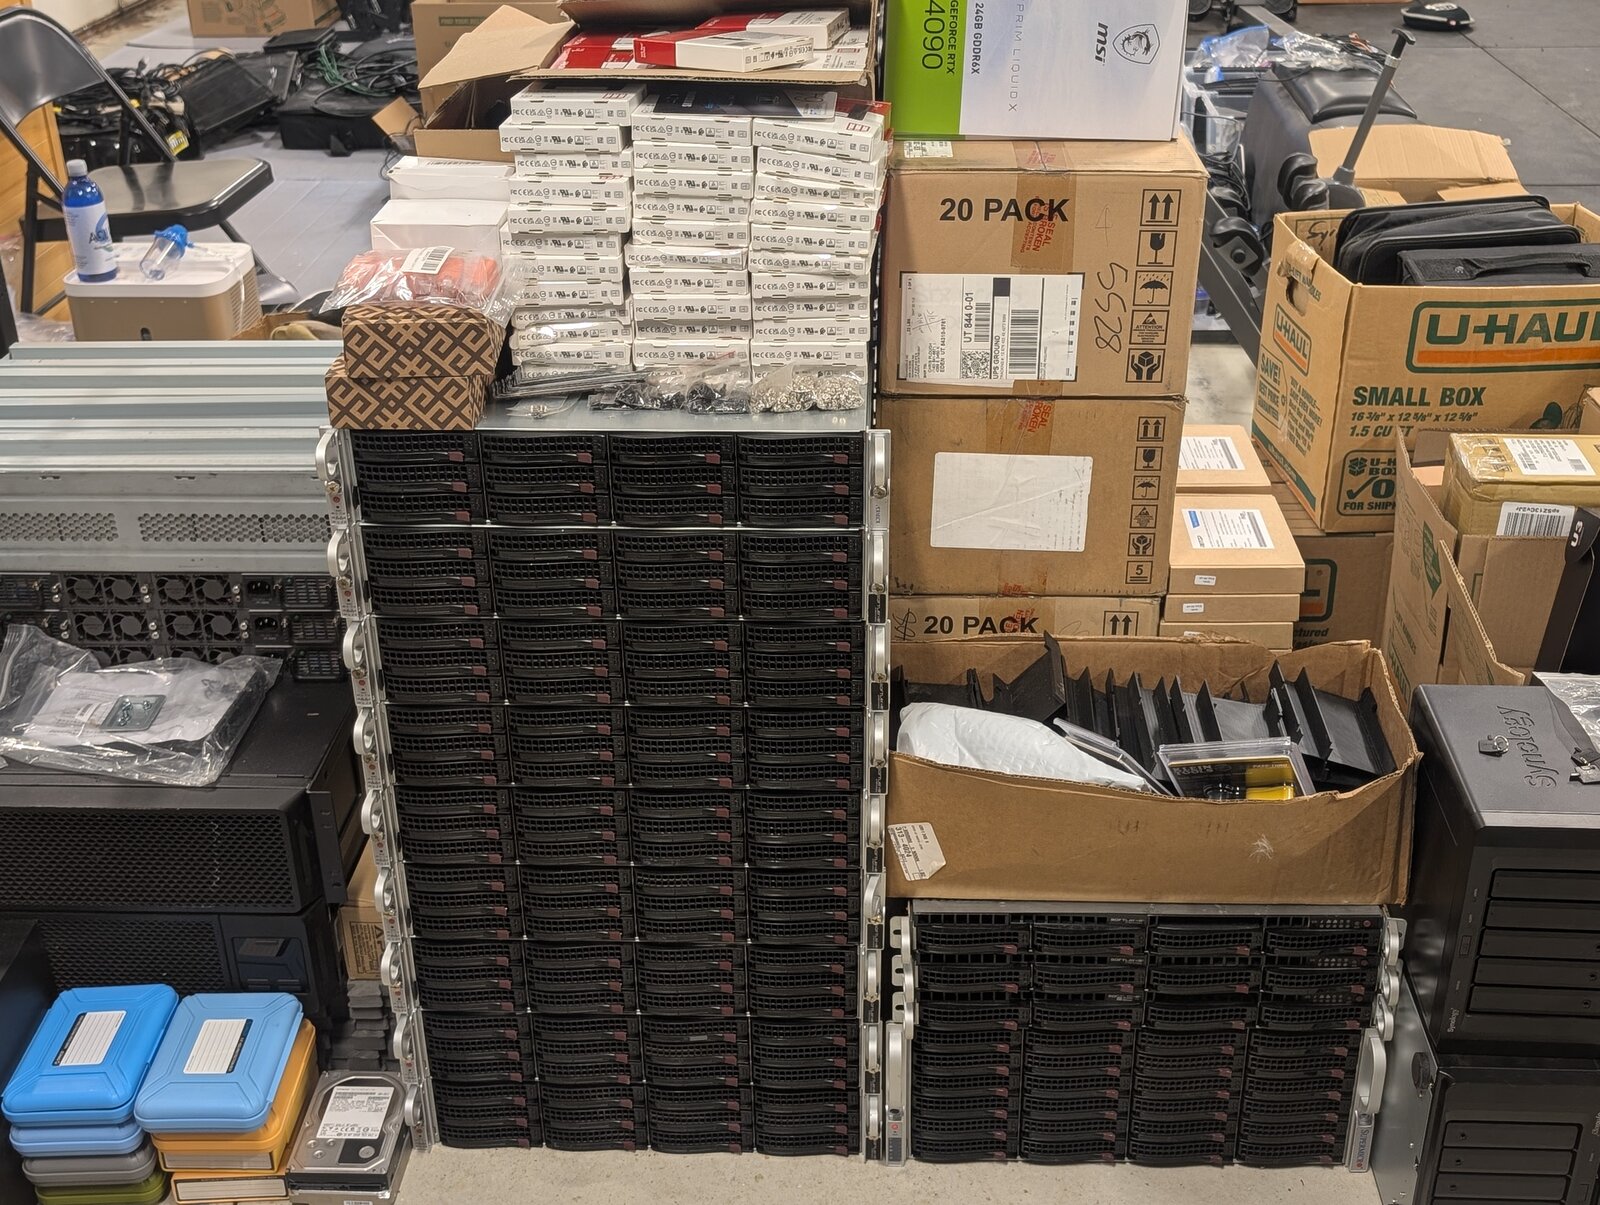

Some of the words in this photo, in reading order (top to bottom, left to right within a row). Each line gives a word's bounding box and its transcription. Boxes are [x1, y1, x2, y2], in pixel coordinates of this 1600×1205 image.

[948, 0, 959, 50] GEFORCE
[973, 2, 984, 30] 24GB
[1014, 0, 1025, 42] PRIM
[921, 0, 946, 70] 4090
[1094, 22, 1109, 63] msi
[946, 53, 956, 75] RTX
[971, 32, 982, 75] GDDR6X
[1009, 48, 1021, 99] LIQUID
[1008, 103, 1018, 112] X
[940, 198, 974, 222] 20
[983, 198, 1070, 222] PACK
[1019, 222, 1032, 253] ACCEPTING
[1041, 222, 1057, 247] SEAL
[963, 291, 975, 311] 0-01
[963, 313, 974, 328] 844
[963, 331, 973, 343] UT
[1276, 311, 1308, 359] U-HAUL
[993, 334, 1001, 365] GROUND
[992, 365, 1000, 380] UPS
[1260, 352, 1281, 386] SAVE!
[1352, 386, 1430, 407] SMALL
[1439, 386, 1487, 406] BOX
[1037, 404, 1053, 429] SEAL
[1351, 411, 1365, 421] 16
[1398, 411, 1412, 422] 12
[1444, 411, 1457, 422] 12
[1349, 425, 1371, 437] 1.5
[1373, 425, 1393, 437] CU
[1343, 502, 1364, 511] FOR
[1134, 564, 1144, 575] 5
[923, 615, 954, 635] 20
[962, 615, 1039, 635] PACK
[1497, 705, 1559, 789] Synology
[895, 826, 905, 838] 313
[902, 843, 912, 858] 4024
